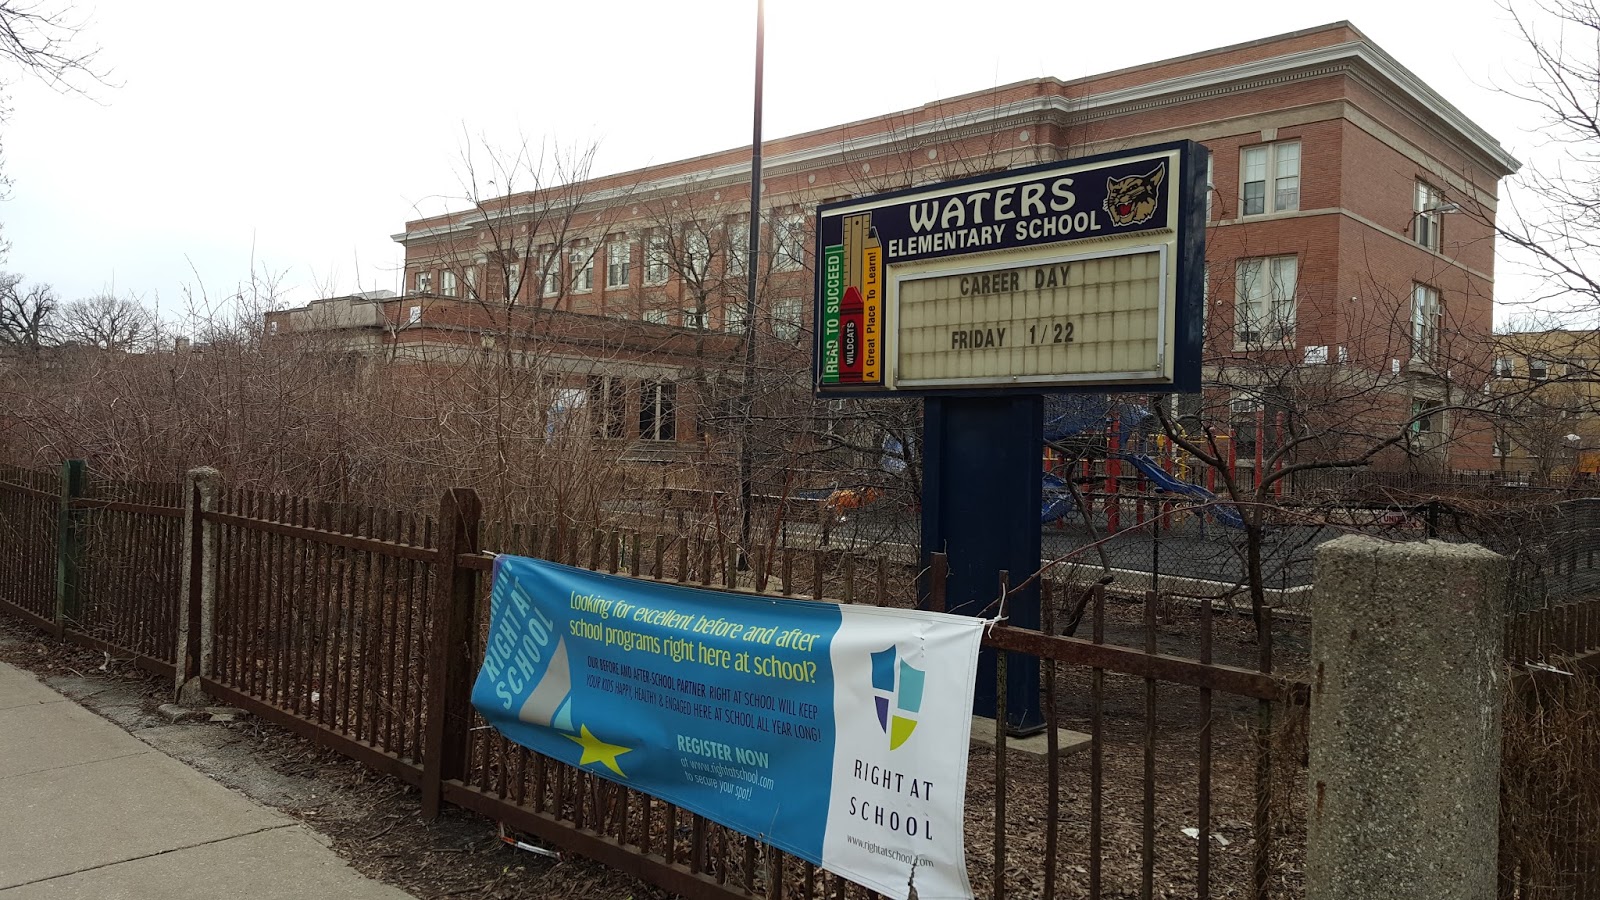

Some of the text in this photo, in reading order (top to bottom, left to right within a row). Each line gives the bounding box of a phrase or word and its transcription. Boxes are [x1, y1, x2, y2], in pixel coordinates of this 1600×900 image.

[909, 178, 1076, 233] WATERS
[888, 210, 1101, 257] ELEMENTARY SCHOOL
[867, 252, 876, 284] Learn!
[960, 265, 1071, 296] CAREER DAY
[826, 255, 840, 373] READ TO SUCCEED
[866, 289, 876, 301] To
[866, 305, 876, 333] Place
[951, 322, 1074, 349] FRIDAY 1/22
[846, 322, 855, 365] WILDCATS
[865, 339, 876, 367] Great
[484, 604, 522, 683] RIGHT
[510, 576, 532, 618] AT
[570, 590, 820, 652] Looking for excellent before and after
[496, 606, 554, 710] SCHOOL
[569, 618, 817, 684] school programs right here at school?
[586, 674, 822, 743] YOUR KIDS HAPPY, HEALTHY & ENGAGED HERE AT SCHOOL ALL YEAR LONG!
[587, 655, 819, 720] OUR BEFORE AND AFTER-SCHOOL PARTNER RIGHT AT SCHOOL WILL KEEP
[677, 734, 769, 769] REGISTER NOW
[680, 757, 775, 791] at www.rightatschool.com
[684, 770, 753, 801] to secure your spot!
[854, 759, 934, 802] RIGHT AT
[849, 796, 933, 841] SCHOOL
